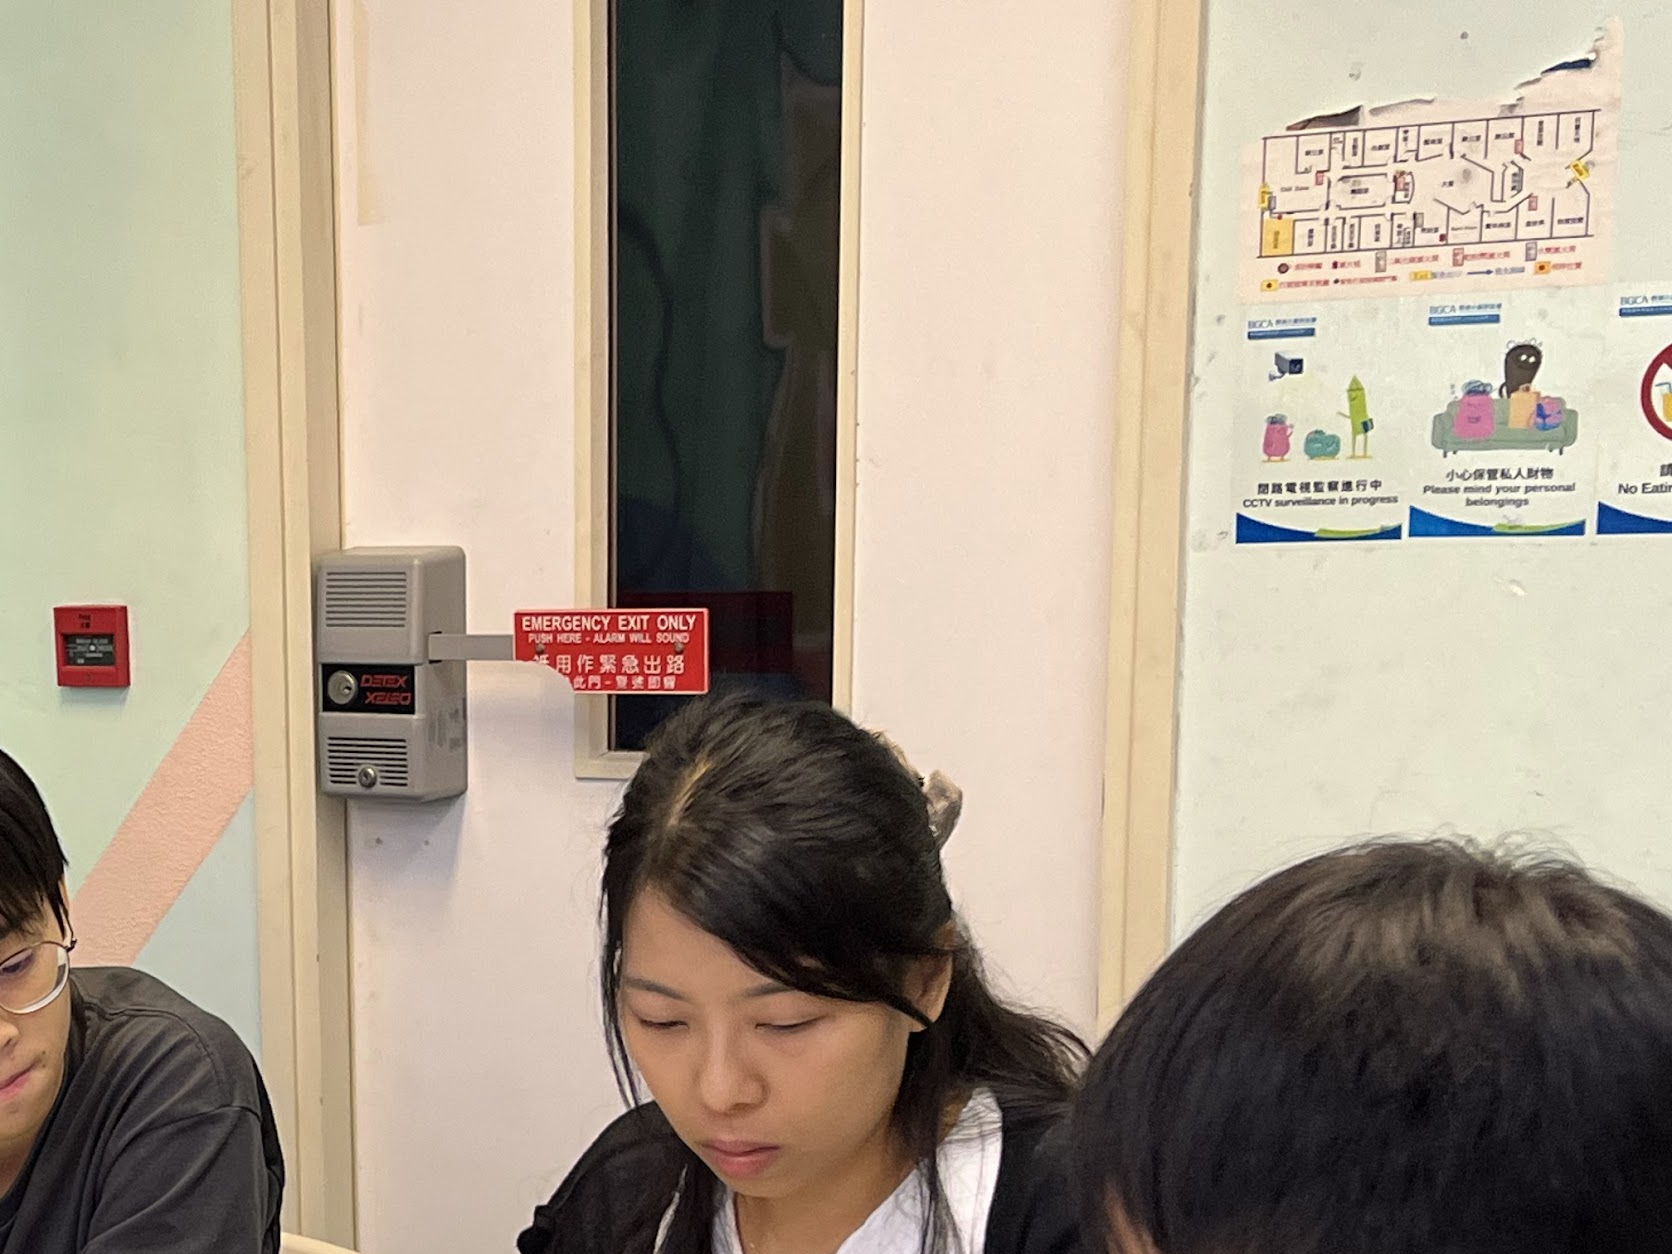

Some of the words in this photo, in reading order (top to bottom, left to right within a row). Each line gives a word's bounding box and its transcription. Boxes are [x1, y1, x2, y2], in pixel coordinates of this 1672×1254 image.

[1446, 468, 1554, 482] 小心保管私人財物
[1423, 485, 1460, 494] Please
[1463, 484, 1492, 493] mind
[1495, 485, 1521, 495] your
[1524, 483, 1576, 493] personal
[1618, 484, 1638, 494] No
[1243, 498, 1272, 508] CCTV
[1274, 496, 1336, 507] surveillance
[1338, 495, 1349, 504] in
[1351, 496, 1399, 506] progress
[1465, 498, 1530, 508] belongings
[521, 615, 611, 632] EMERGENCY
[617, 615, 650, 631] EXIT
[657, 614, 696, 631] ONLY
[528, 633, 553, 644] PUSH
[557, 633, 582, 643] HERE
[593, 633, 626, 643] ALARM
[629, 632, 652, 643] WILL
[656, 632, 690, 643] SOUND
[360, 674, 408, 688] DETEX
